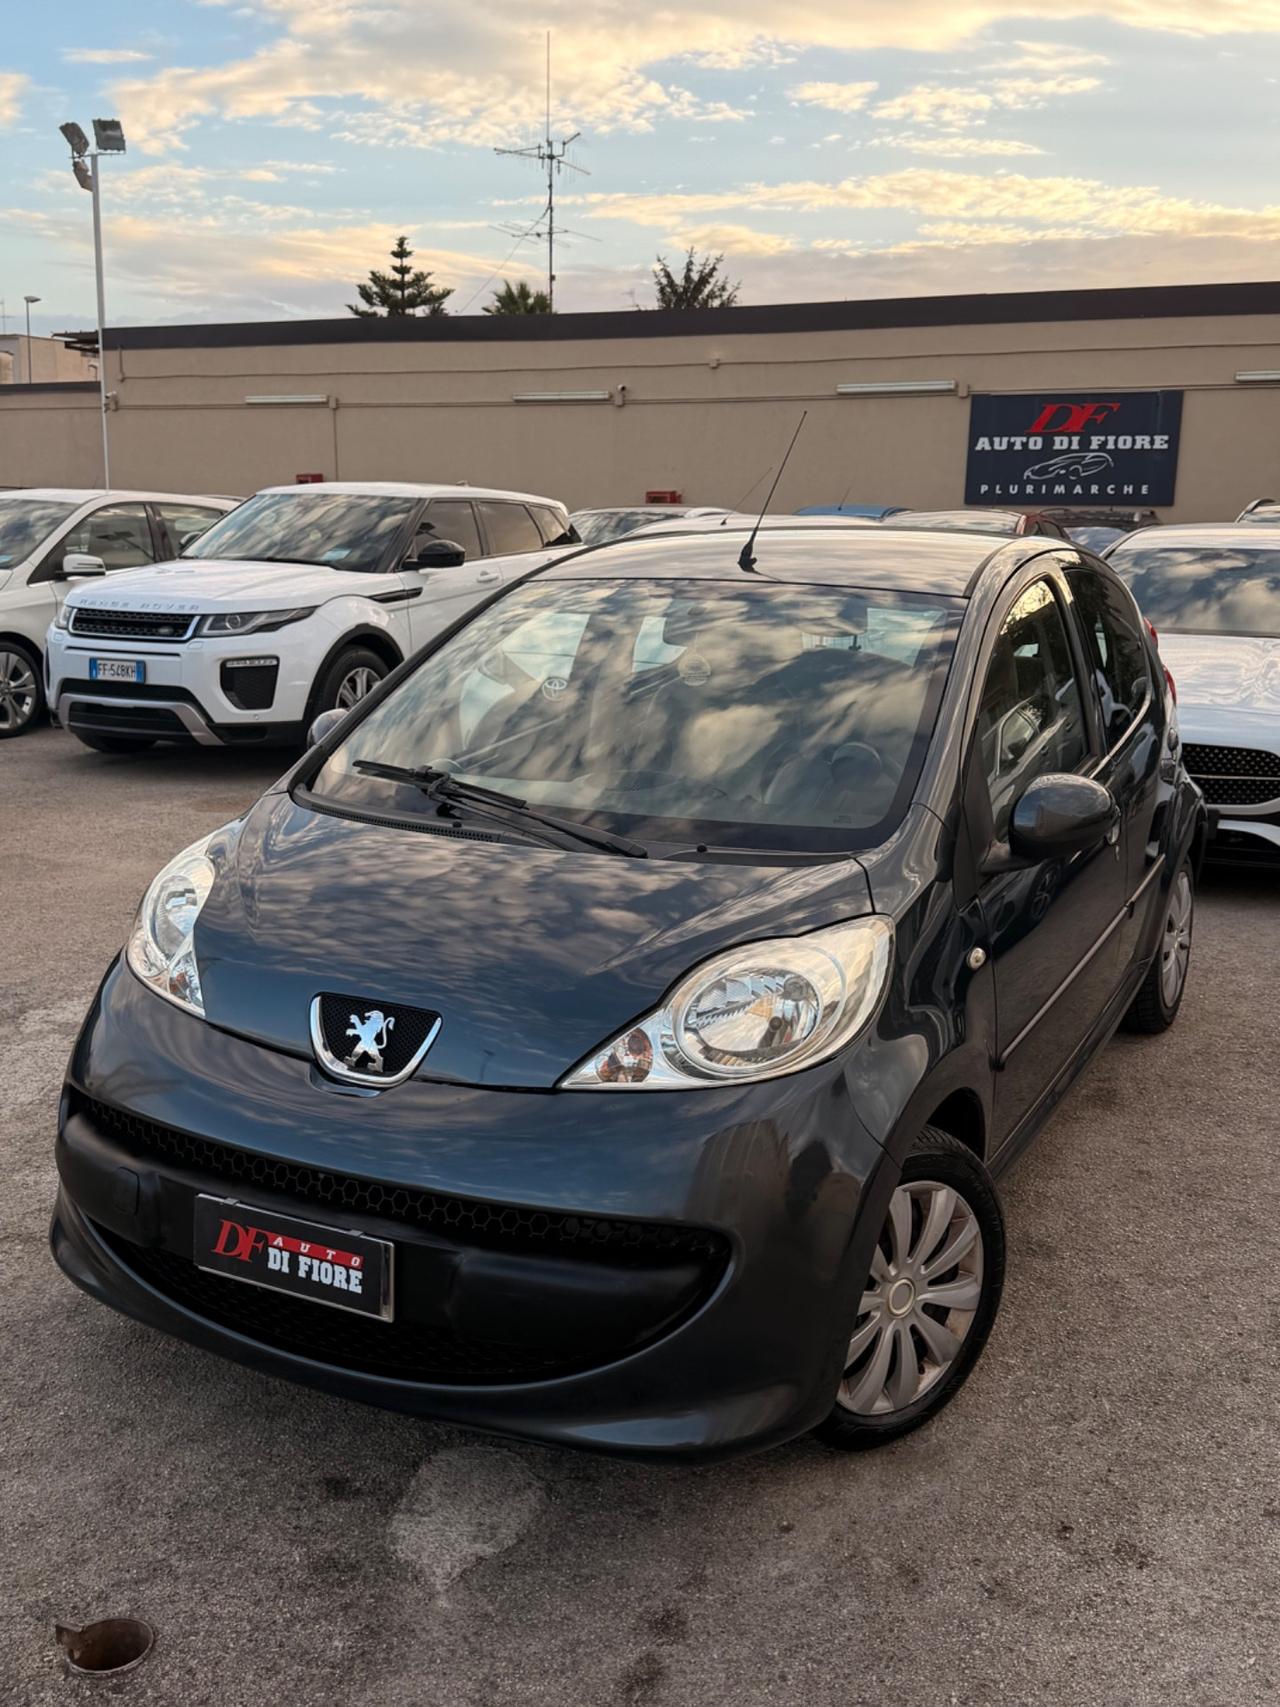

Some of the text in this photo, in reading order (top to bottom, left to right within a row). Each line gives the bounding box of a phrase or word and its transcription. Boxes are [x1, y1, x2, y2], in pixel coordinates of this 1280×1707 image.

[1025, 403, 1120, 433] DF
[975, 434, 1169, 451] AUTO DI FIORE
[980, 484, 1149, 495] PLURIMARCHE
[211, 1219, 268, 1262] DF
[272, 1236, 361, 1267] AUTO
[267, 1246, 363, 1294] DI FIORE
